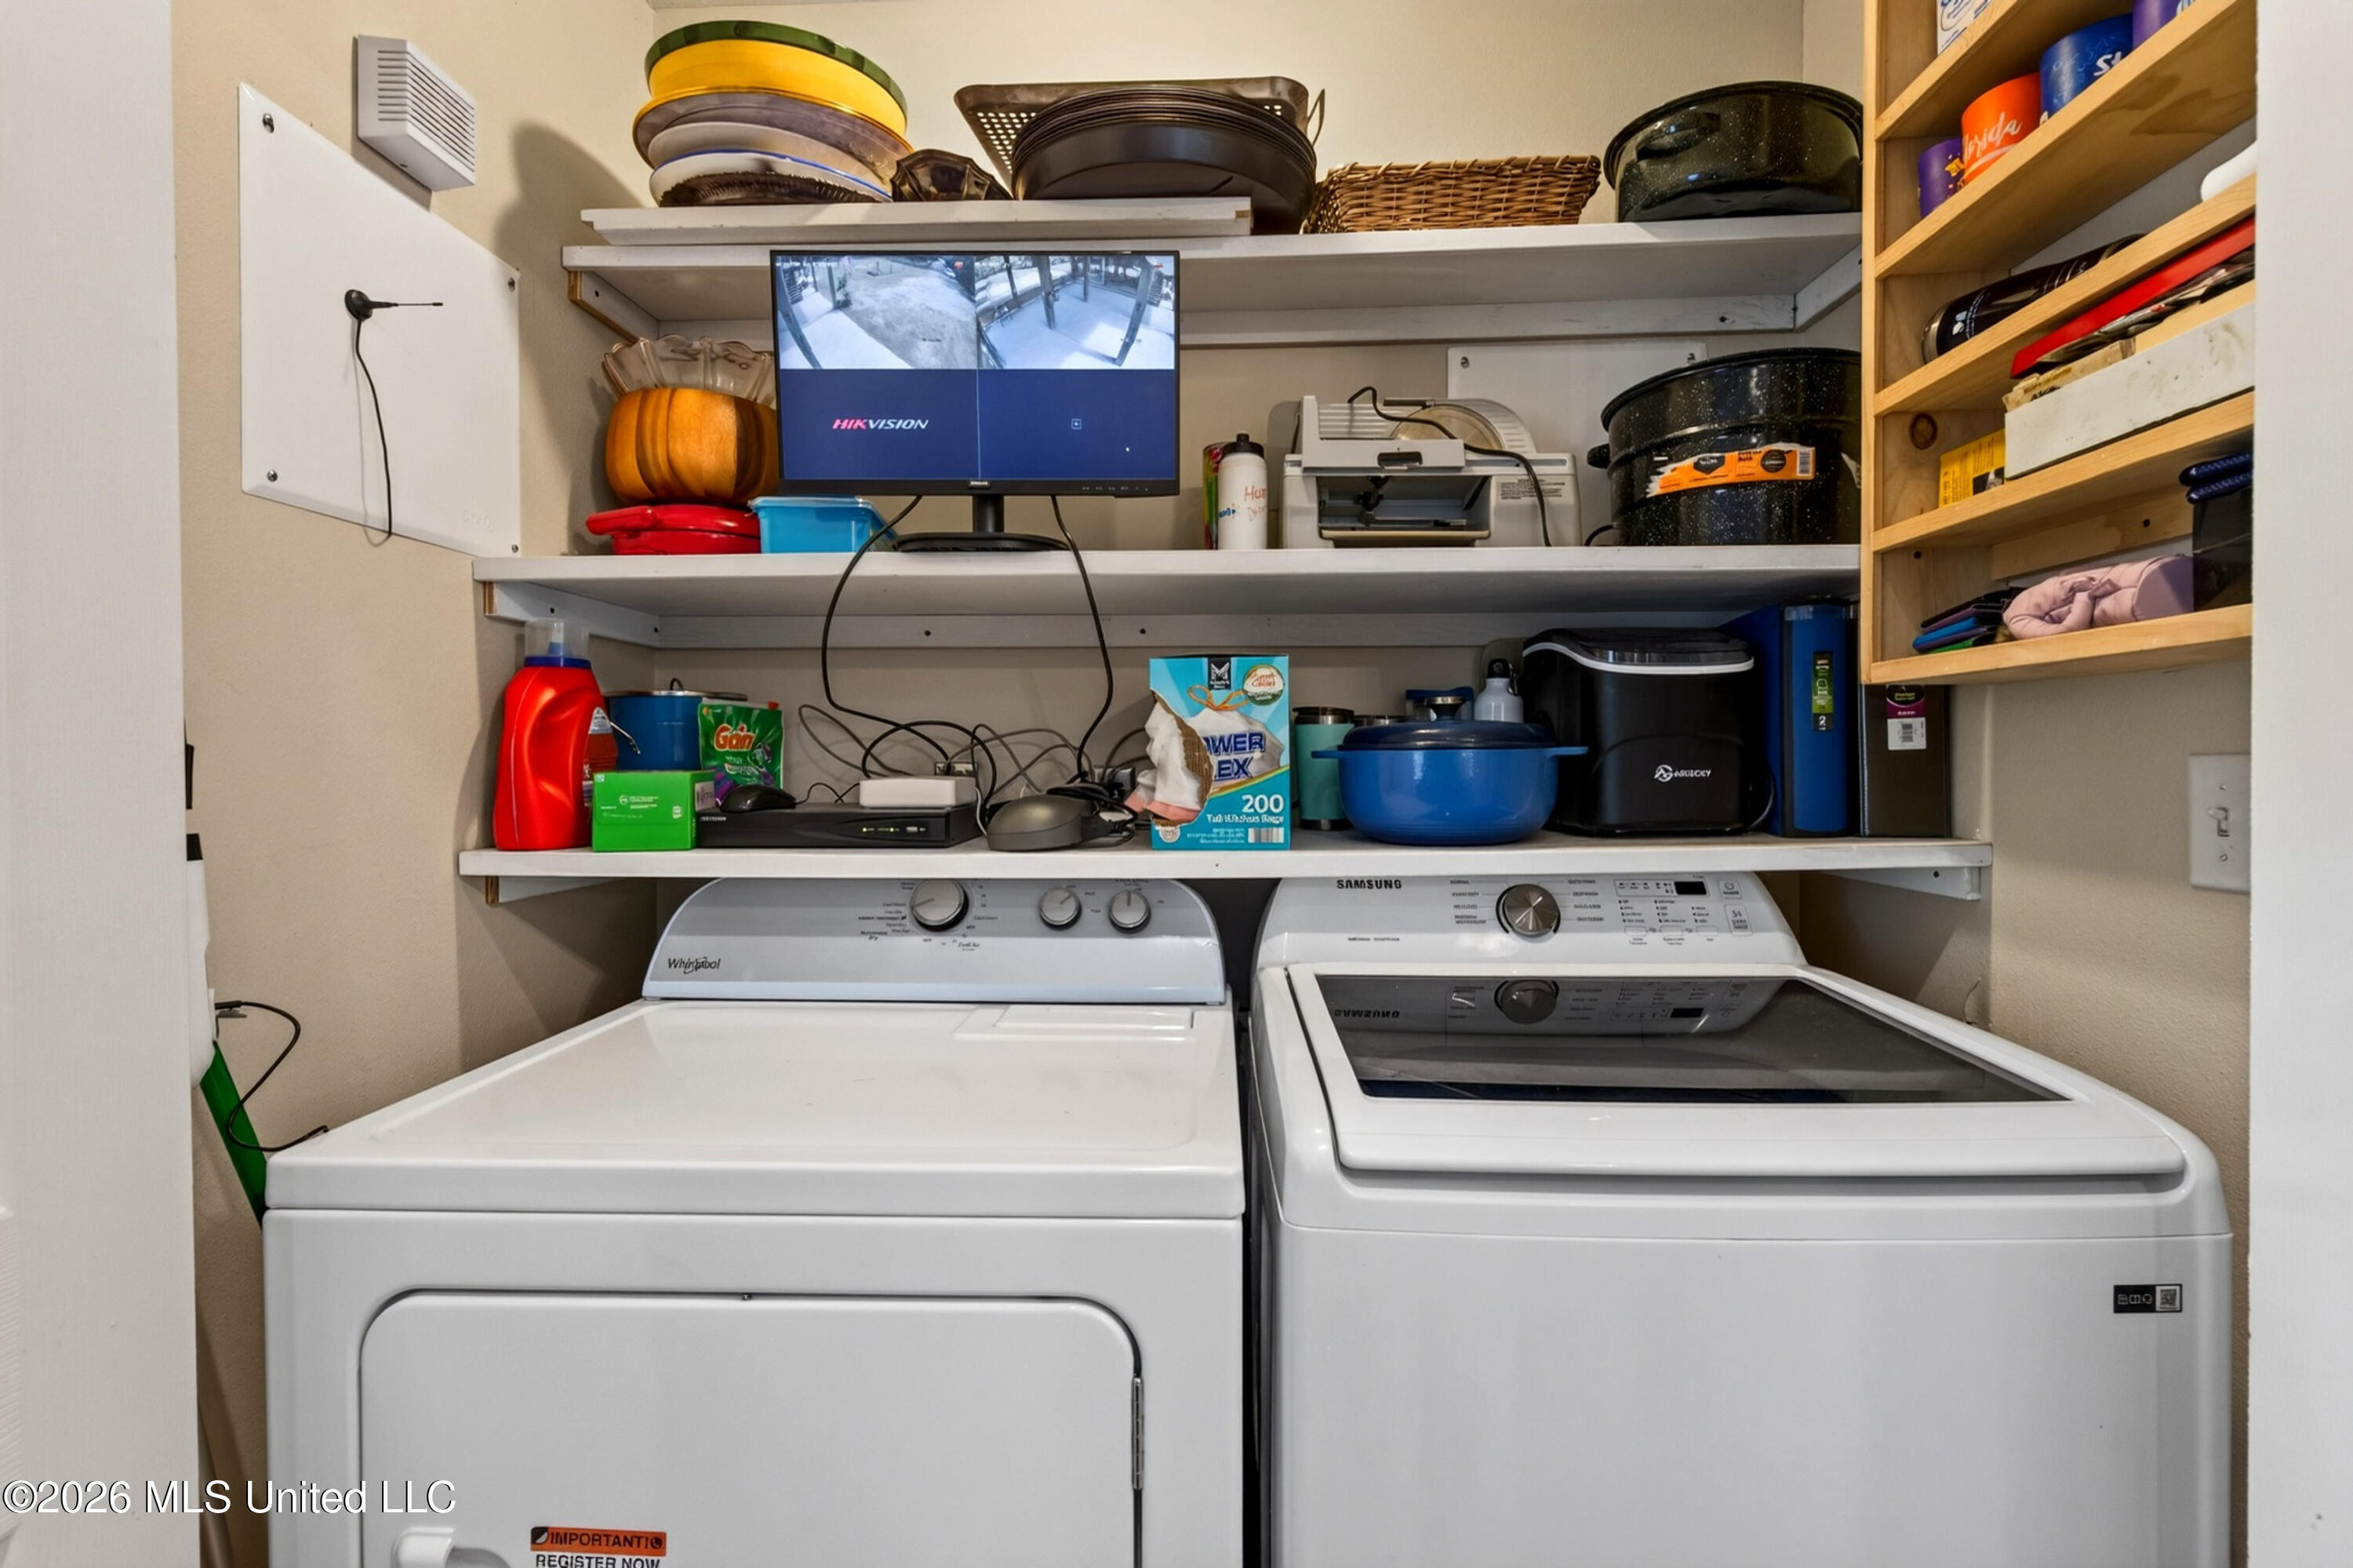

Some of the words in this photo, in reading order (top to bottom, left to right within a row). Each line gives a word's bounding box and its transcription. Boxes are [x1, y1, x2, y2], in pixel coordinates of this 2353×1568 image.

[1962, 111, 2023, 162] lorida
[832, 418, 929, 430] HIKVISION
[1242, 794, 1285, 813] 200
[1337, 879, 1402, 890] SAMSUNG
[668, 956, 721, 974] Whirlpool
[536, 1554, 616, 1568] REGISTER
[622, 1558, 660, 1568] NOW
